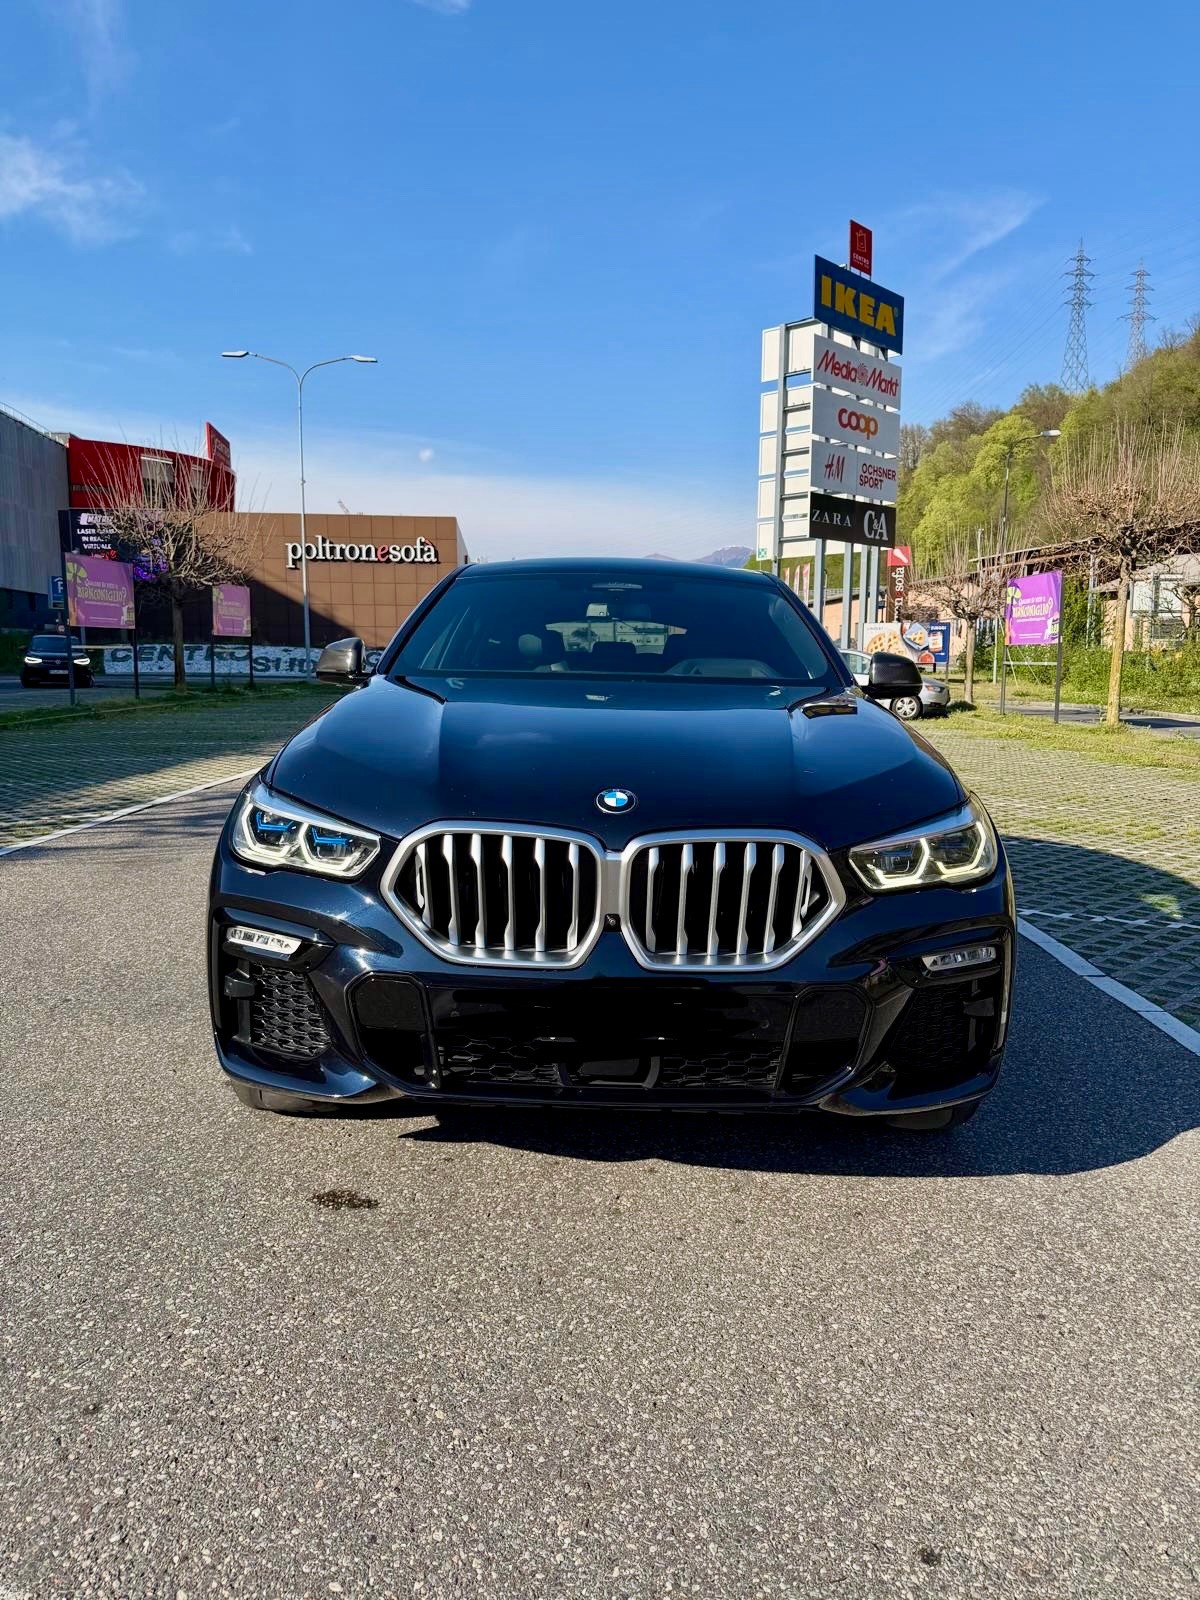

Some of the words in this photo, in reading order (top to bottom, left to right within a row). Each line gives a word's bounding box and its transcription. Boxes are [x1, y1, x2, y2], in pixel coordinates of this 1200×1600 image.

[821, 274, 897, 337] IKEA
[817, 349, 858, 383] Media
[866, 367, 899, 397] Markt
[838, 408, 879, 440] coop
[824, 453, 846, 483] H&M
[859, 474, 884, 491] SPORT
[861, 463, 897, 481] OCHSNER
[812, 509, 852, 527] ZARA
[863, 510, 889, 541] C&A
[285, 535, 438, 569] poltronesofà
